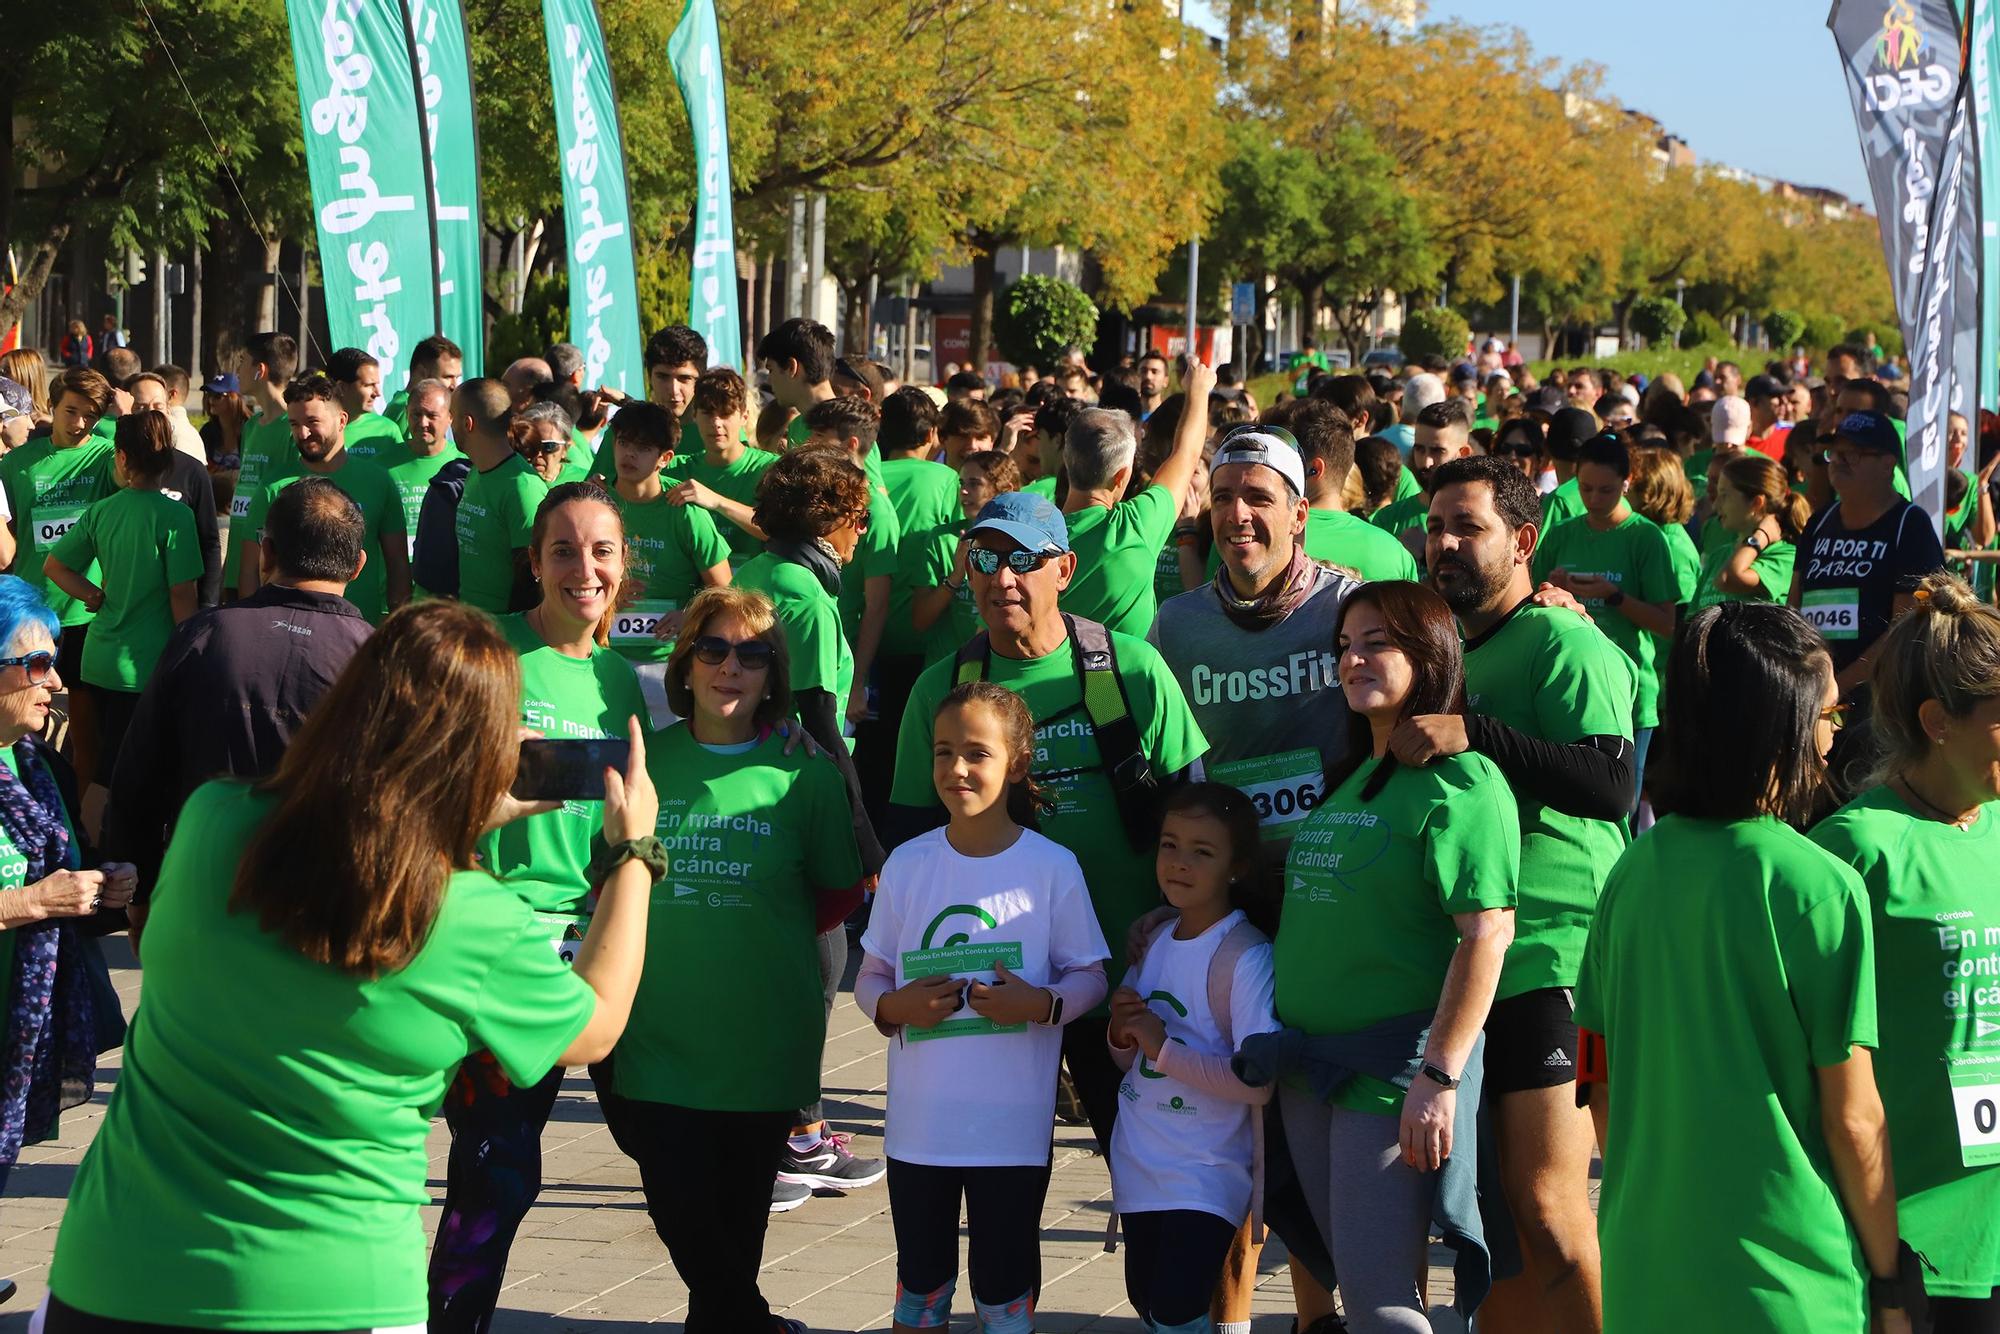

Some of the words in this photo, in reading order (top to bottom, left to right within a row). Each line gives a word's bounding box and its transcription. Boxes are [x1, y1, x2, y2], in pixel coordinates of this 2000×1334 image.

[1812, 537, 1831, 556] VA
[1831, 538, 1868, 558] POR
[1870, 540, 1888, 560] TI
[1806, 558, 1873, 580] PABLO
[1191, 650, 1341, 706] CrossFit
[526, 709, 556, 730] En
[656, 810, 681, 828] En
[687, 814, 772, 836] marcha
[1324, 809, 1378, 828] marcha
[673, 854, 752, 877] cáncer
[1296, 847, 1344, 869] cáncer
[1938, 925, 1977, 951] En
[1943, 982, 1967, 1008] el
